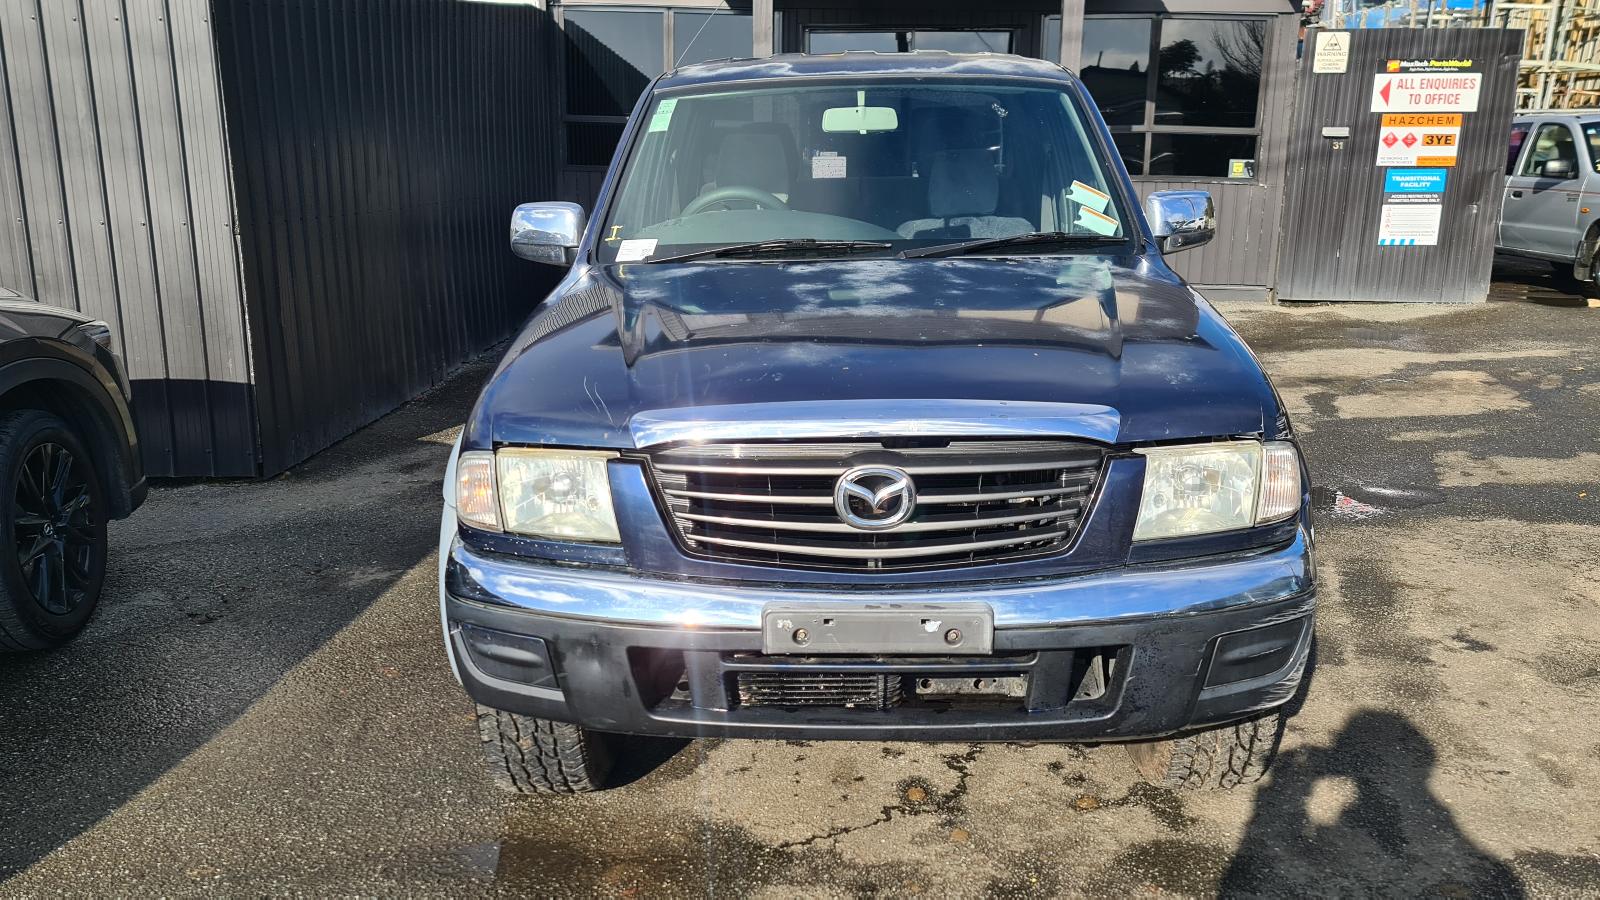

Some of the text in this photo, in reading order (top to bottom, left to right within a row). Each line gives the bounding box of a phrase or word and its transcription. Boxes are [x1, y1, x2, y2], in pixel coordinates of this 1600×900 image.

[1396, 78, 1477, 90] ALL ENQUIRIES
[1409, 93, 1462, 105] TO OFFICE
[1388, 116, 1455, 125] HAZCHEM
[1425, 135, 1452, 145] 3YE
[1332, 141, 1344, 150] 31
